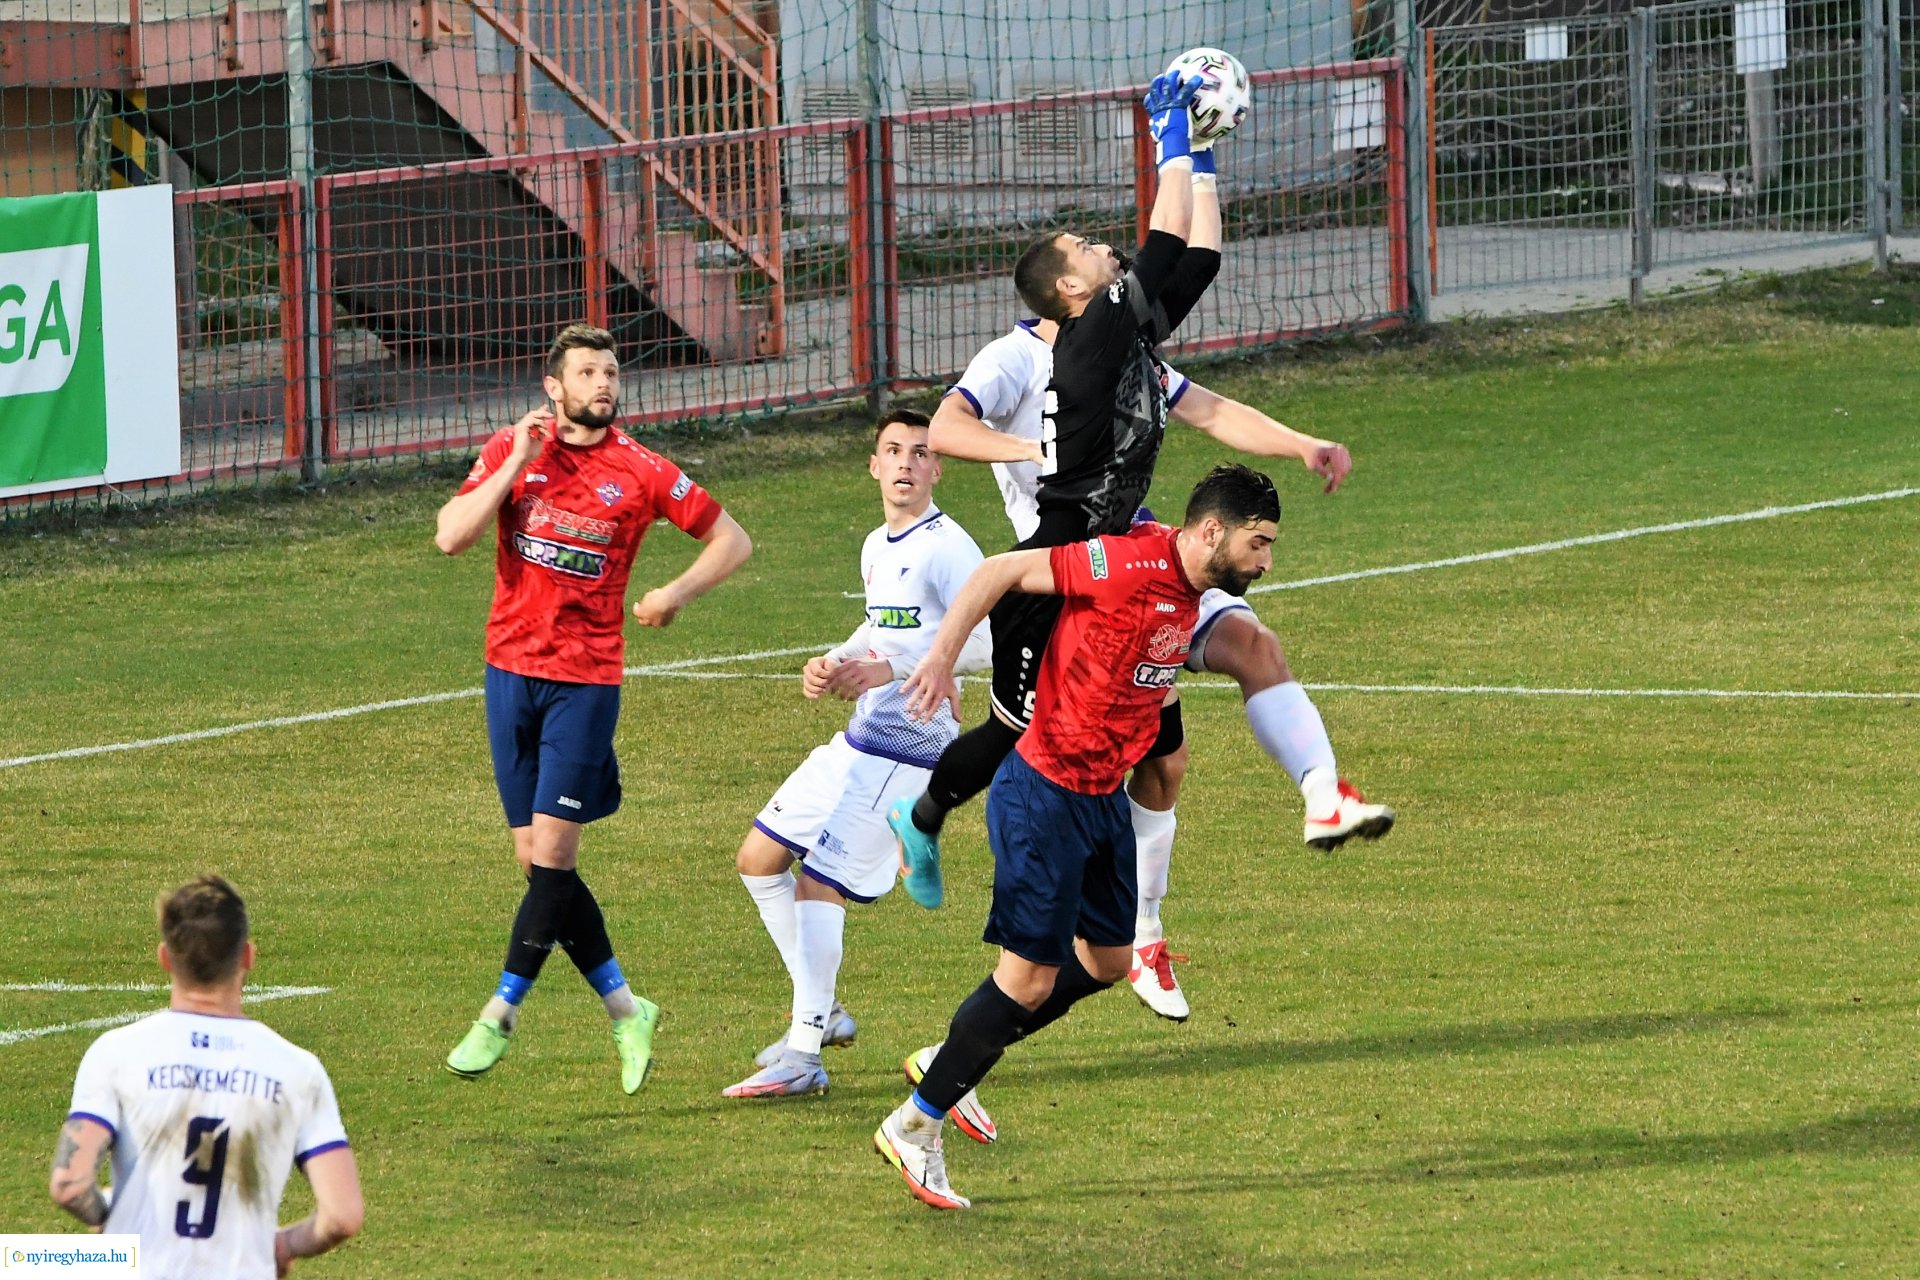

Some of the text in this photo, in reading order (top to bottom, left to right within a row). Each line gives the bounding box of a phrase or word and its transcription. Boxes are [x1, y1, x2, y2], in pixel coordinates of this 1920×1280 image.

[1155, 602, 1176, 612] JAKO
[147, 1064, 283, 1105] KECSKEMÉTI TE
[174, 1117, 230, 1239] 9
